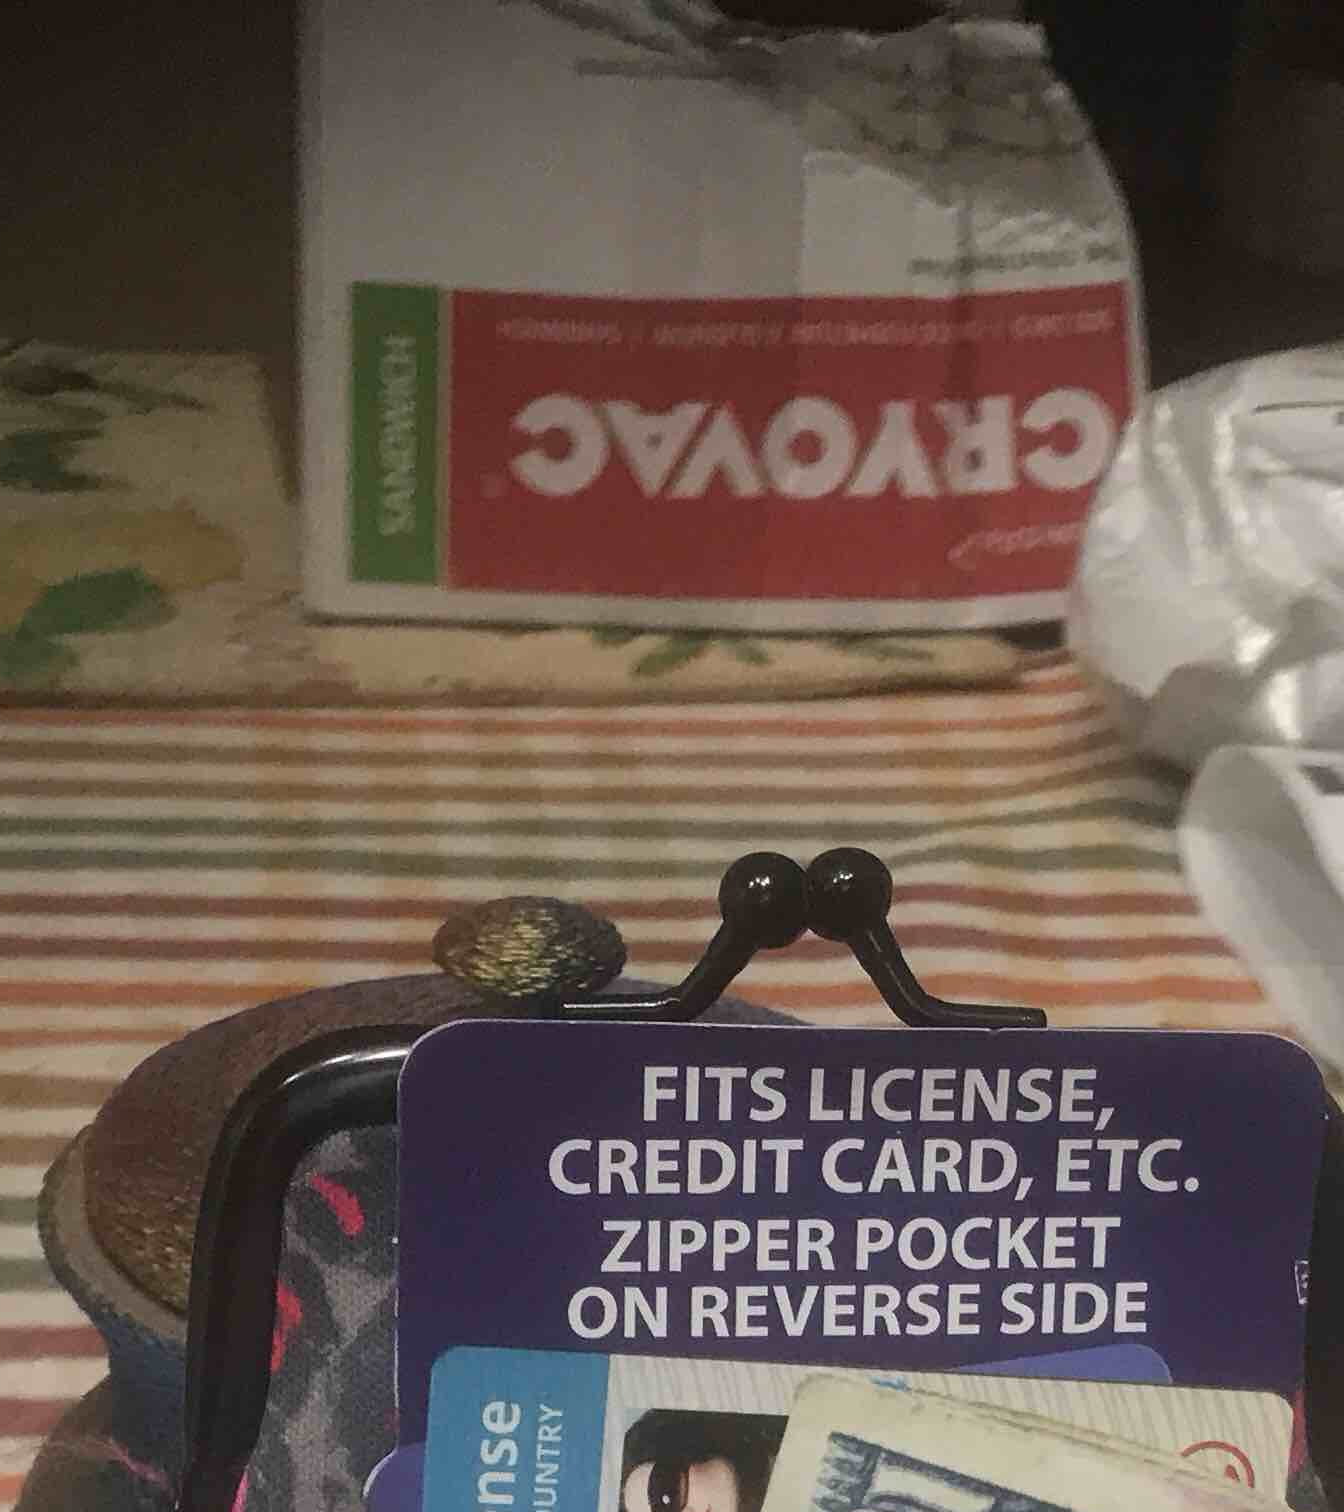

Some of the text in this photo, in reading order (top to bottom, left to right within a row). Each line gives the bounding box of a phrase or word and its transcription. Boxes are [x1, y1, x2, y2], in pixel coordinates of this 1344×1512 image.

[376, 336, 419, 536] SANDWICH
[509, 390, 1115, 501] CRYOVAC
[642, 1066, 1115, 1131] FITS LICENSE,
[548, 1138, 1200, 1201] CREDIT CARD, ETC.
[600, 1216, 1122, 1273] ZIPPER POCKET
[567, 1281, 1149, 1339] ON REVERSE SIDE
